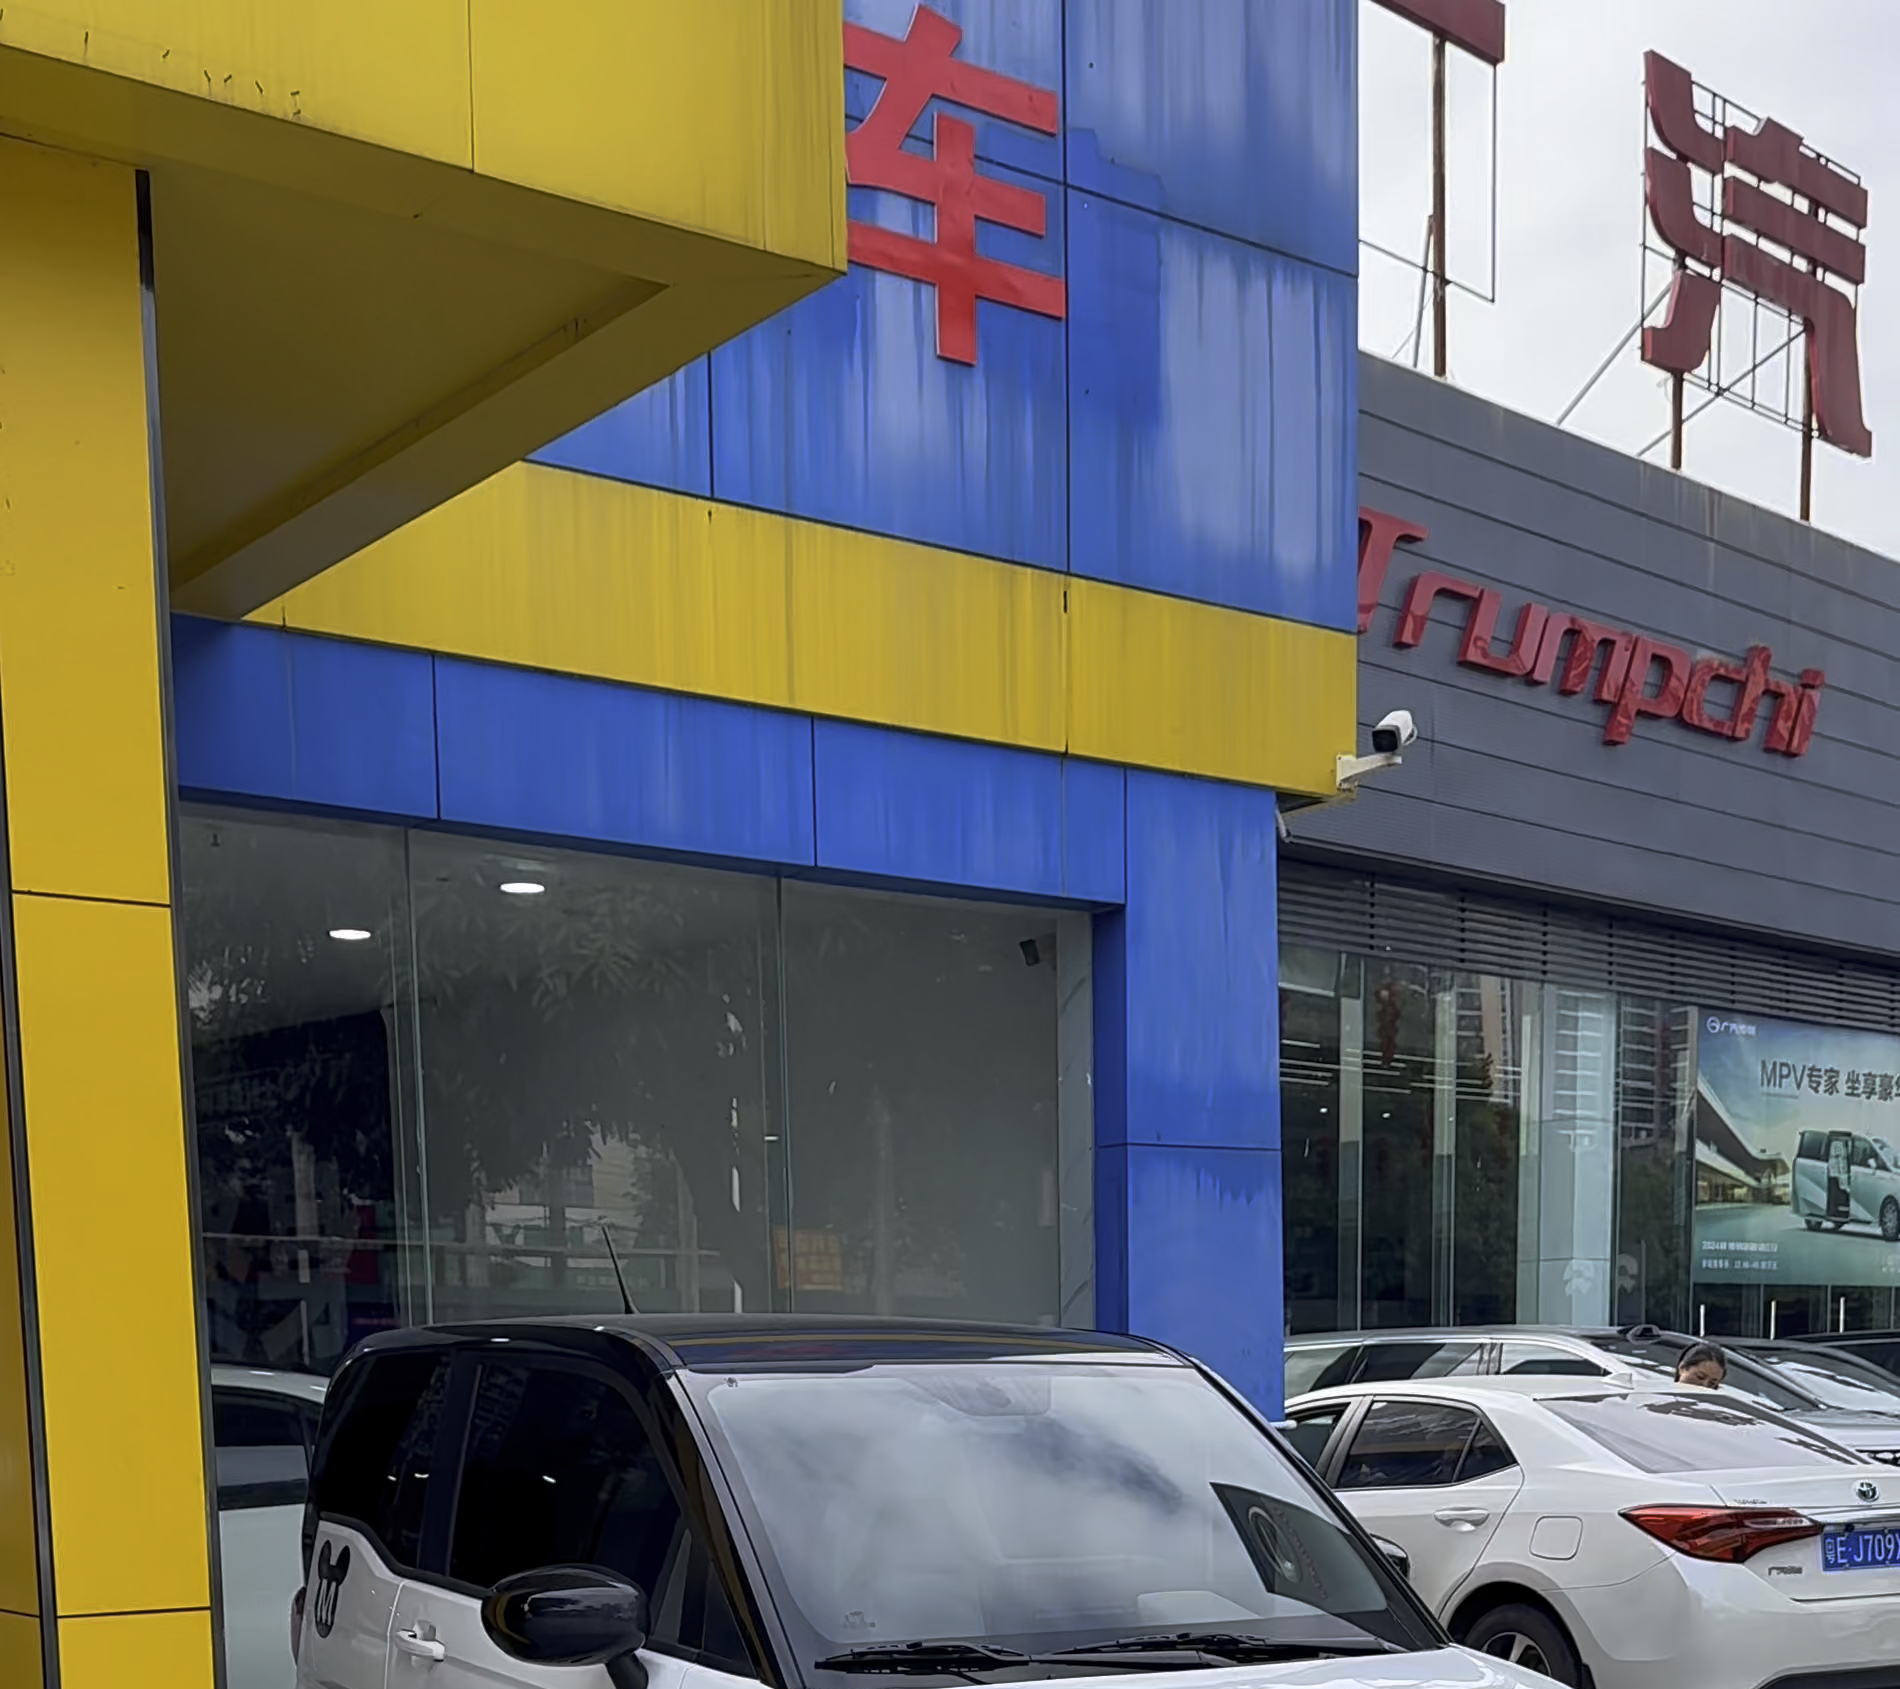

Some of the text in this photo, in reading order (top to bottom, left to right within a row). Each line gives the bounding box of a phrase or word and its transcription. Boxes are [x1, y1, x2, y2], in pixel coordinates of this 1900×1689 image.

[843, 2, 1066, 367] 车
[1641, 49, 1872, 459] 汽
[1358, 506, 1826, 757] Trumpchi
[1760, 1059, 1840, 1096] MPV专家
